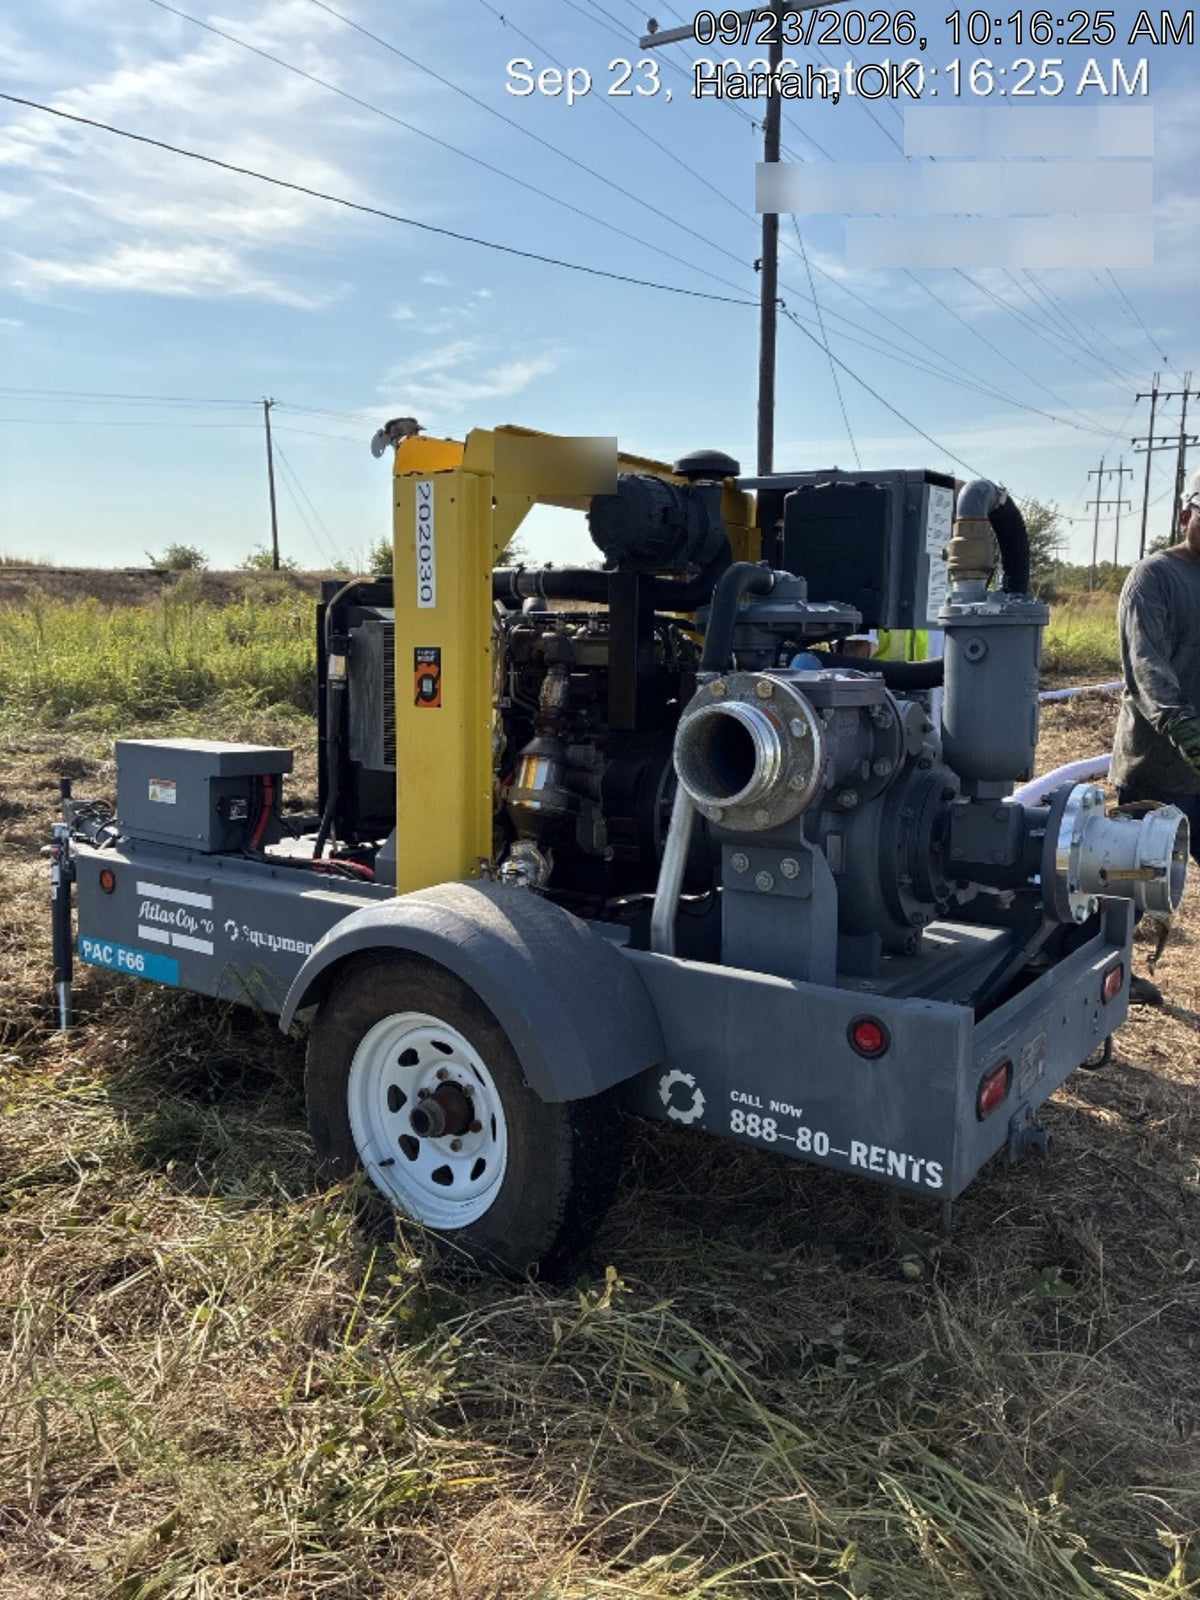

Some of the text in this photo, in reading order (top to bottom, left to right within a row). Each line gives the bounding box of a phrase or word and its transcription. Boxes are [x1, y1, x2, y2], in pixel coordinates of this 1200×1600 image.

[418, 483, 433, 603] 202030
[138, 901, 175, 925] Atlas
[82, 940, 145, 972] PAC F66
[241, 925, 314, 956] quipmen
[730, 1090, 803, 1118] CALL NOW
[729, 1108, 944, 1189] 888-80-RENTS
